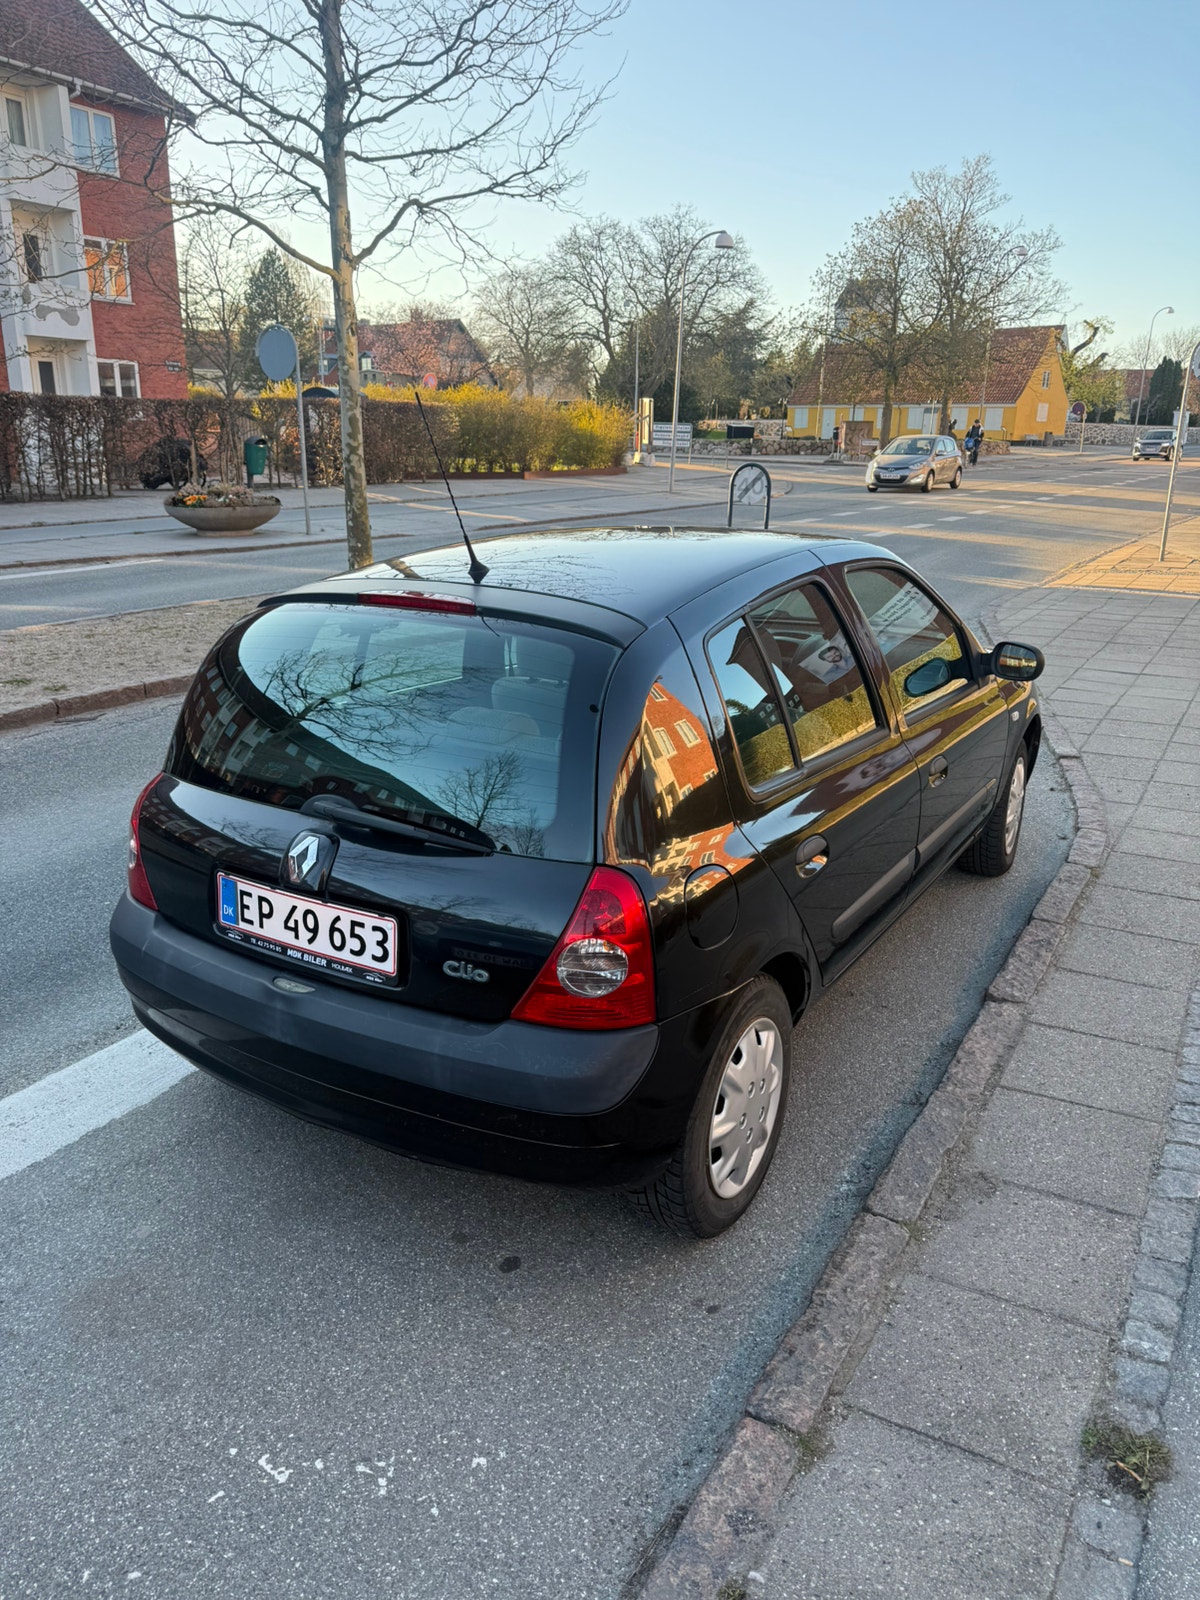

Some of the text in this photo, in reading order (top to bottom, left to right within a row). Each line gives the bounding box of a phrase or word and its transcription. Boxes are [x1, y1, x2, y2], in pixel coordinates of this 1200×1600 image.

[737, 478, 764, 495] 40
[223, 904, 234, 918] DK
[239, 889, 389, 963] EP 49 653
[303, 953, 327, 967] BILER
[331, 962, 353, 974] HOLBÆK
[442, 960, 490, 982] Clio
